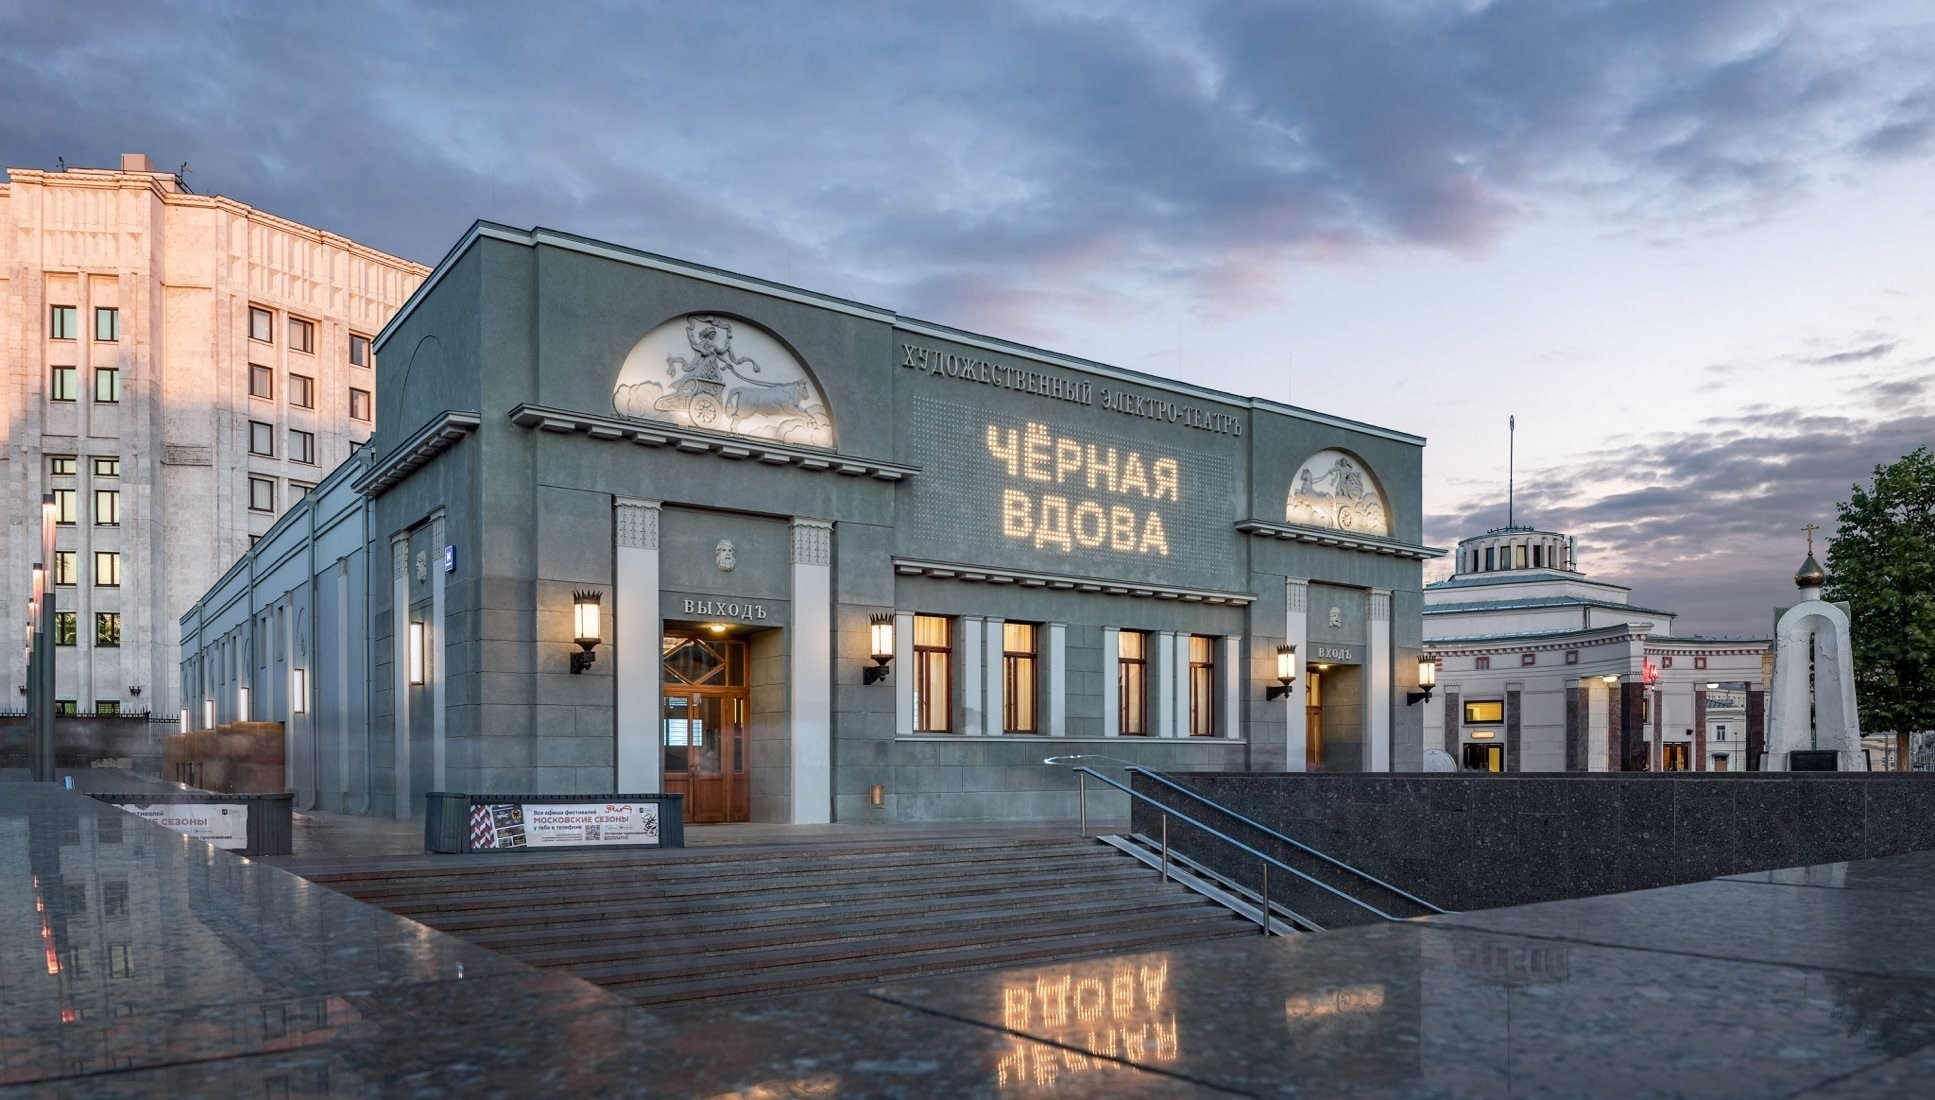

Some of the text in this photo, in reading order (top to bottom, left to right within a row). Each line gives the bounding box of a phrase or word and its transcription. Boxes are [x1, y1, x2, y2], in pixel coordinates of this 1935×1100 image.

[902, 343, 1243, 437] ХУДОЖЕСТВЕННЫЙ ЭЛЕКТРО-ТЕАТРЪ
[985, 421, 1179, 502] ЧЁРНАЯ
[1002, 489, 1169, 556] ВДОВА
[684, 599, 767, 620] ВЫХОДЪ
[1318, 647, 1352, 660] ВХОДЪ
[161, 818, 207, 826] СЕЗОНЫ
[533, 816, 593, 824] МОСКОВСКИЕ
